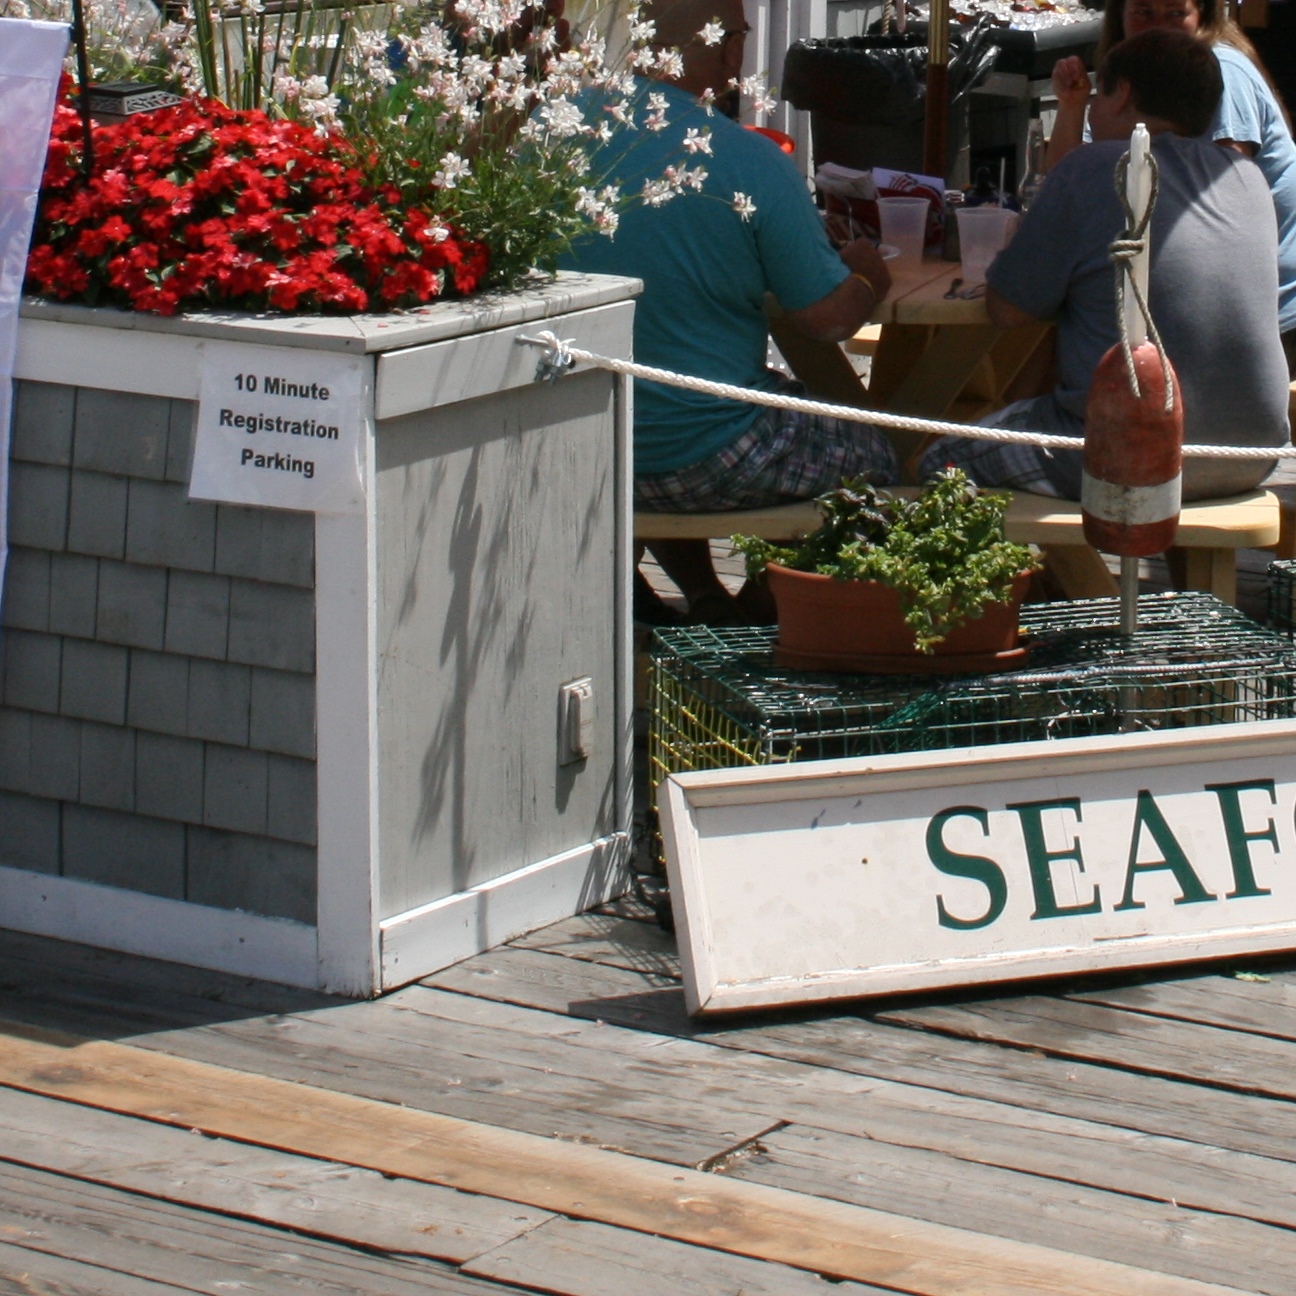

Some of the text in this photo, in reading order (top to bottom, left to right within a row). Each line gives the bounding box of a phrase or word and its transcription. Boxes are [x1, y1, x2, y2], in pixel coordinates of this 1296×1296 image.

[235, 373, 330, 401] 10 Minute
[219, 408, 339, 440] Registration
[241, 448, 315, 479] Parking
